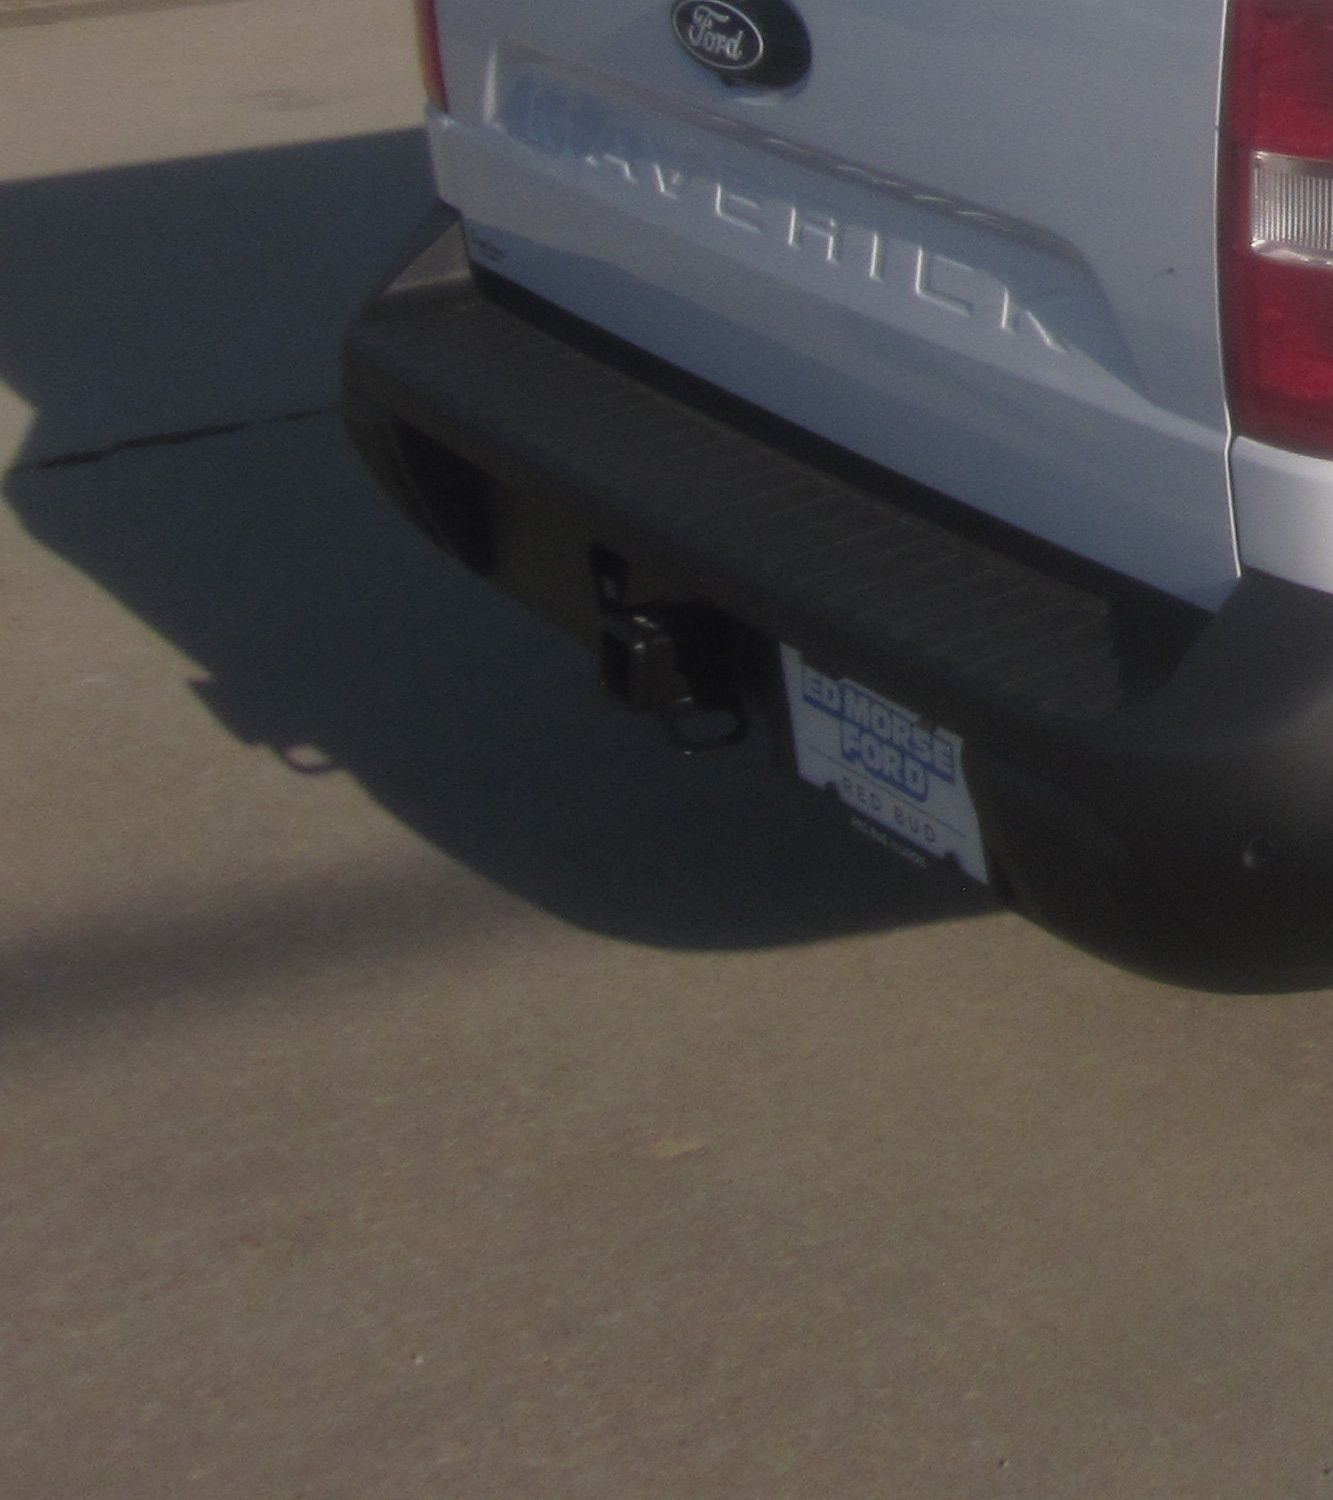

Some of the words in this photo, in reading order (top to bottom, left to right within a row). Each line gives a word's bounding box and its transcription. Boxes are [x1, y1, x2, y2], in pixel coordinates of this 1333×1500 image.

[688, 5, 745, 61] Ford
[842, 722, 925, 797] FORD
[843, 688, 952, 773] MORSE
[843, 778, 881, 811] RED
[893, 805, 936, 843] BUD
